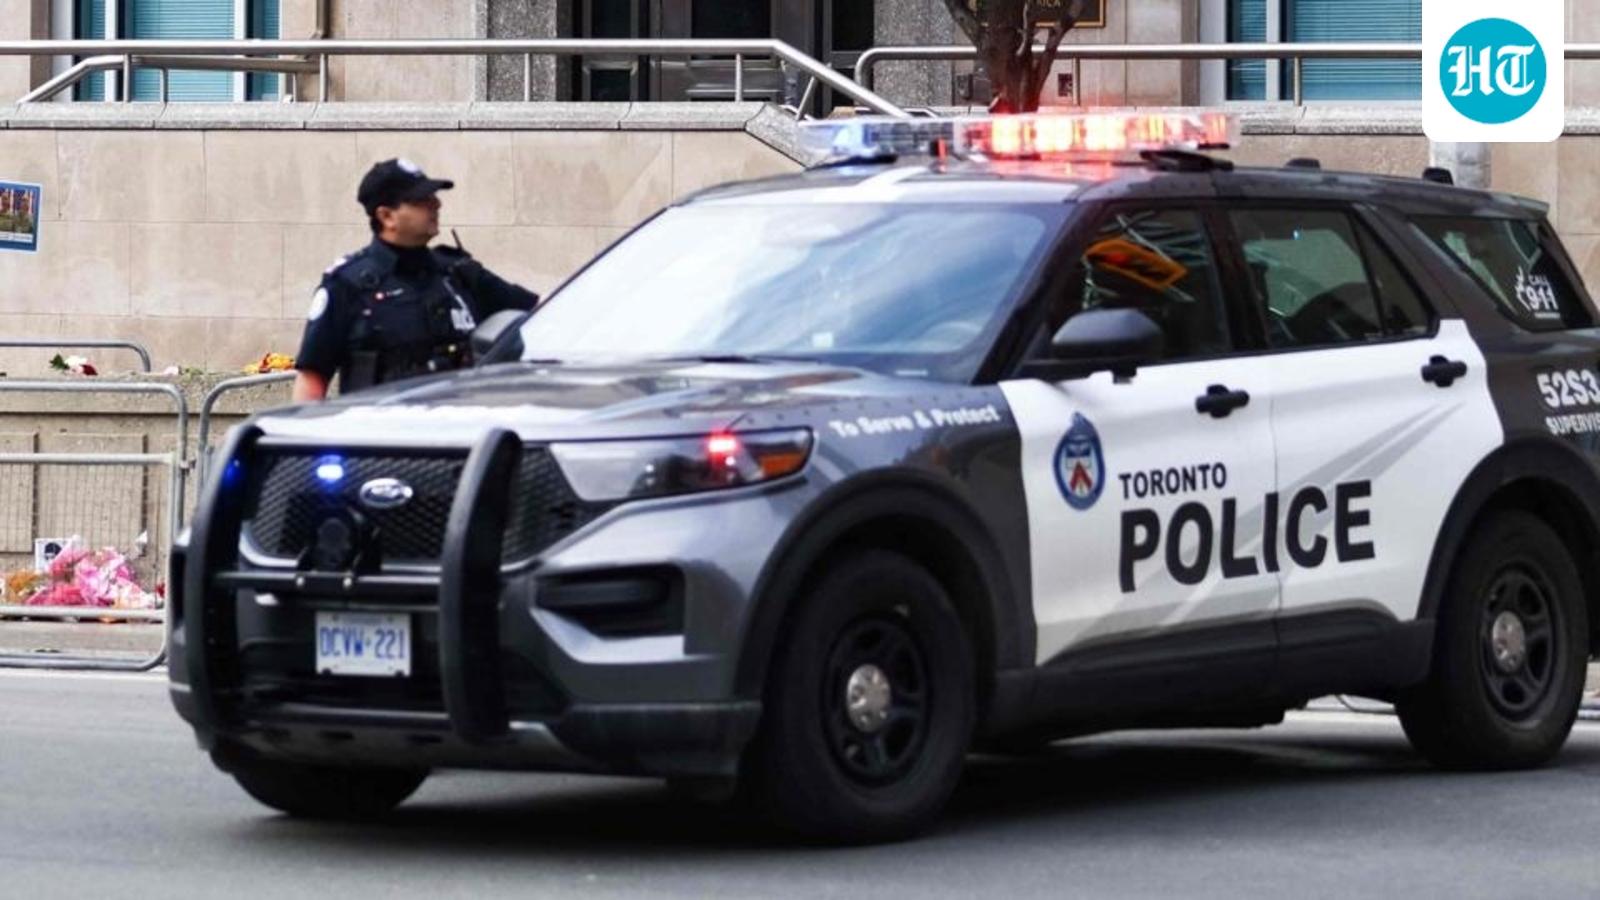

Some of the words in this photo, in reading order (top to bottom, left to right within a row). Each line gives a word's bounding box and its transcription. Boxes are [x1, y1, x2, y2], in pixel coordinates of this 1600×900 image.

[1526, 286, 1559, 310] 911
[1528, 275, 1550, 286] CALL
[1536, 369, 1600, 408] 52S3
[828, 420, 859, 438] To
[857, 416, 914, 435] Serve
[913, 409, 933, 429] &
[931, 404, 999, 427] Protect
[1118, 462, 1227, 500] TORONTO
[1118, 480, 1376, 594] POLICE
